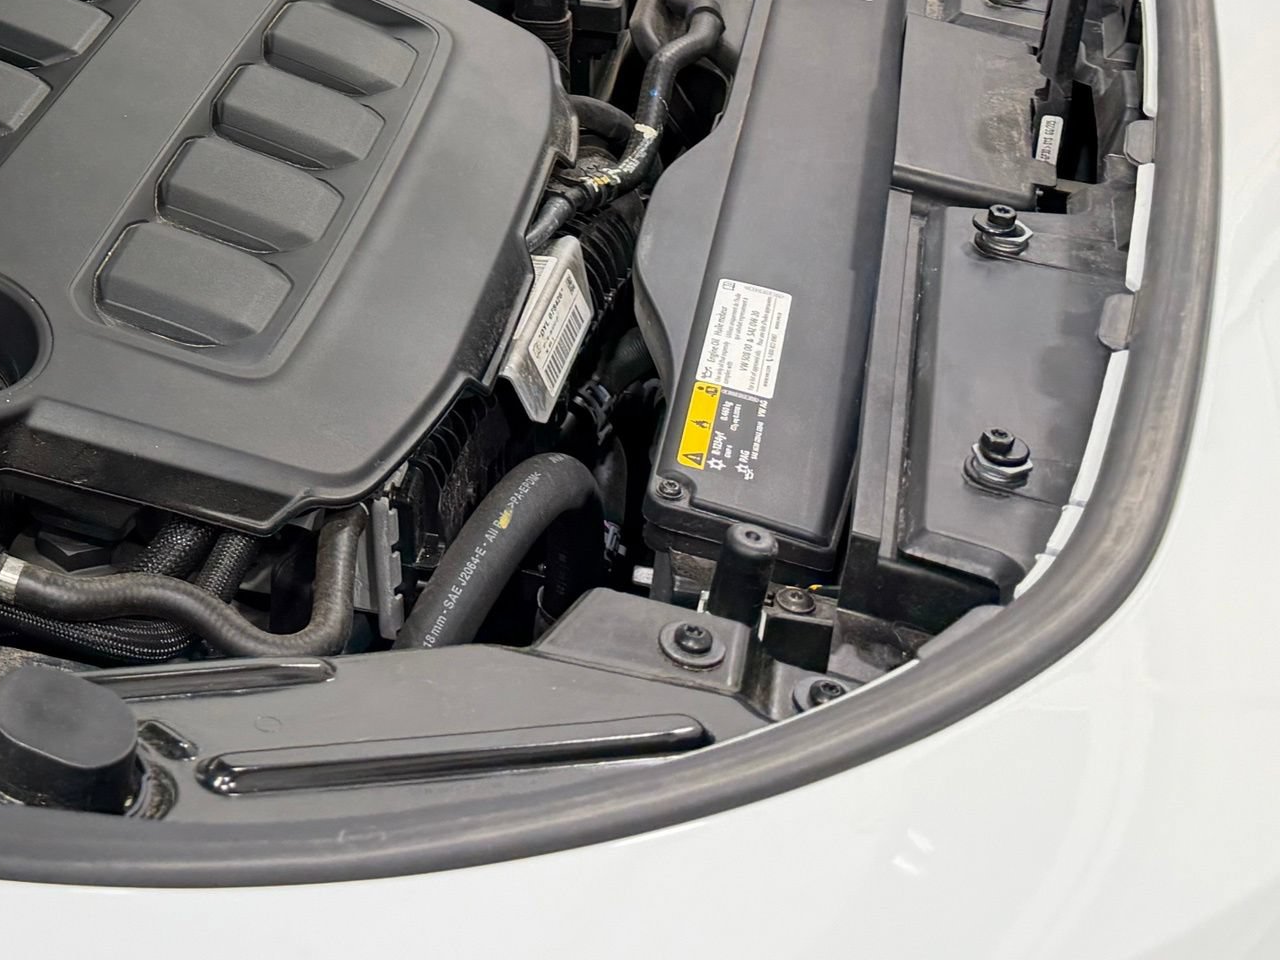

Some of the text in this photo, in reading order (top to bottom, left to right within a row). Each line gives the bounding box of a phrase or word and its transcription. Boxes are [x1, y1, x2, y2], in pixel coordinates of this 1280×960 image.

[750, 309, 760, 317] 20
[706, 305, 727, 363] Engine Oil Huile moteur
[746, 326, 756, 337] SAE
[743, 343, 752, 351] 00
[741, 351, 751, 361] 508
[738, 361, 748, 371] VW
[757, 407, 767, 418] VW
[738, 449, 750, 463] PAG
[432, 616, 448, 638] mm
[444, 585, 463, 610] SAE
[486, 528, 499, 544] All
